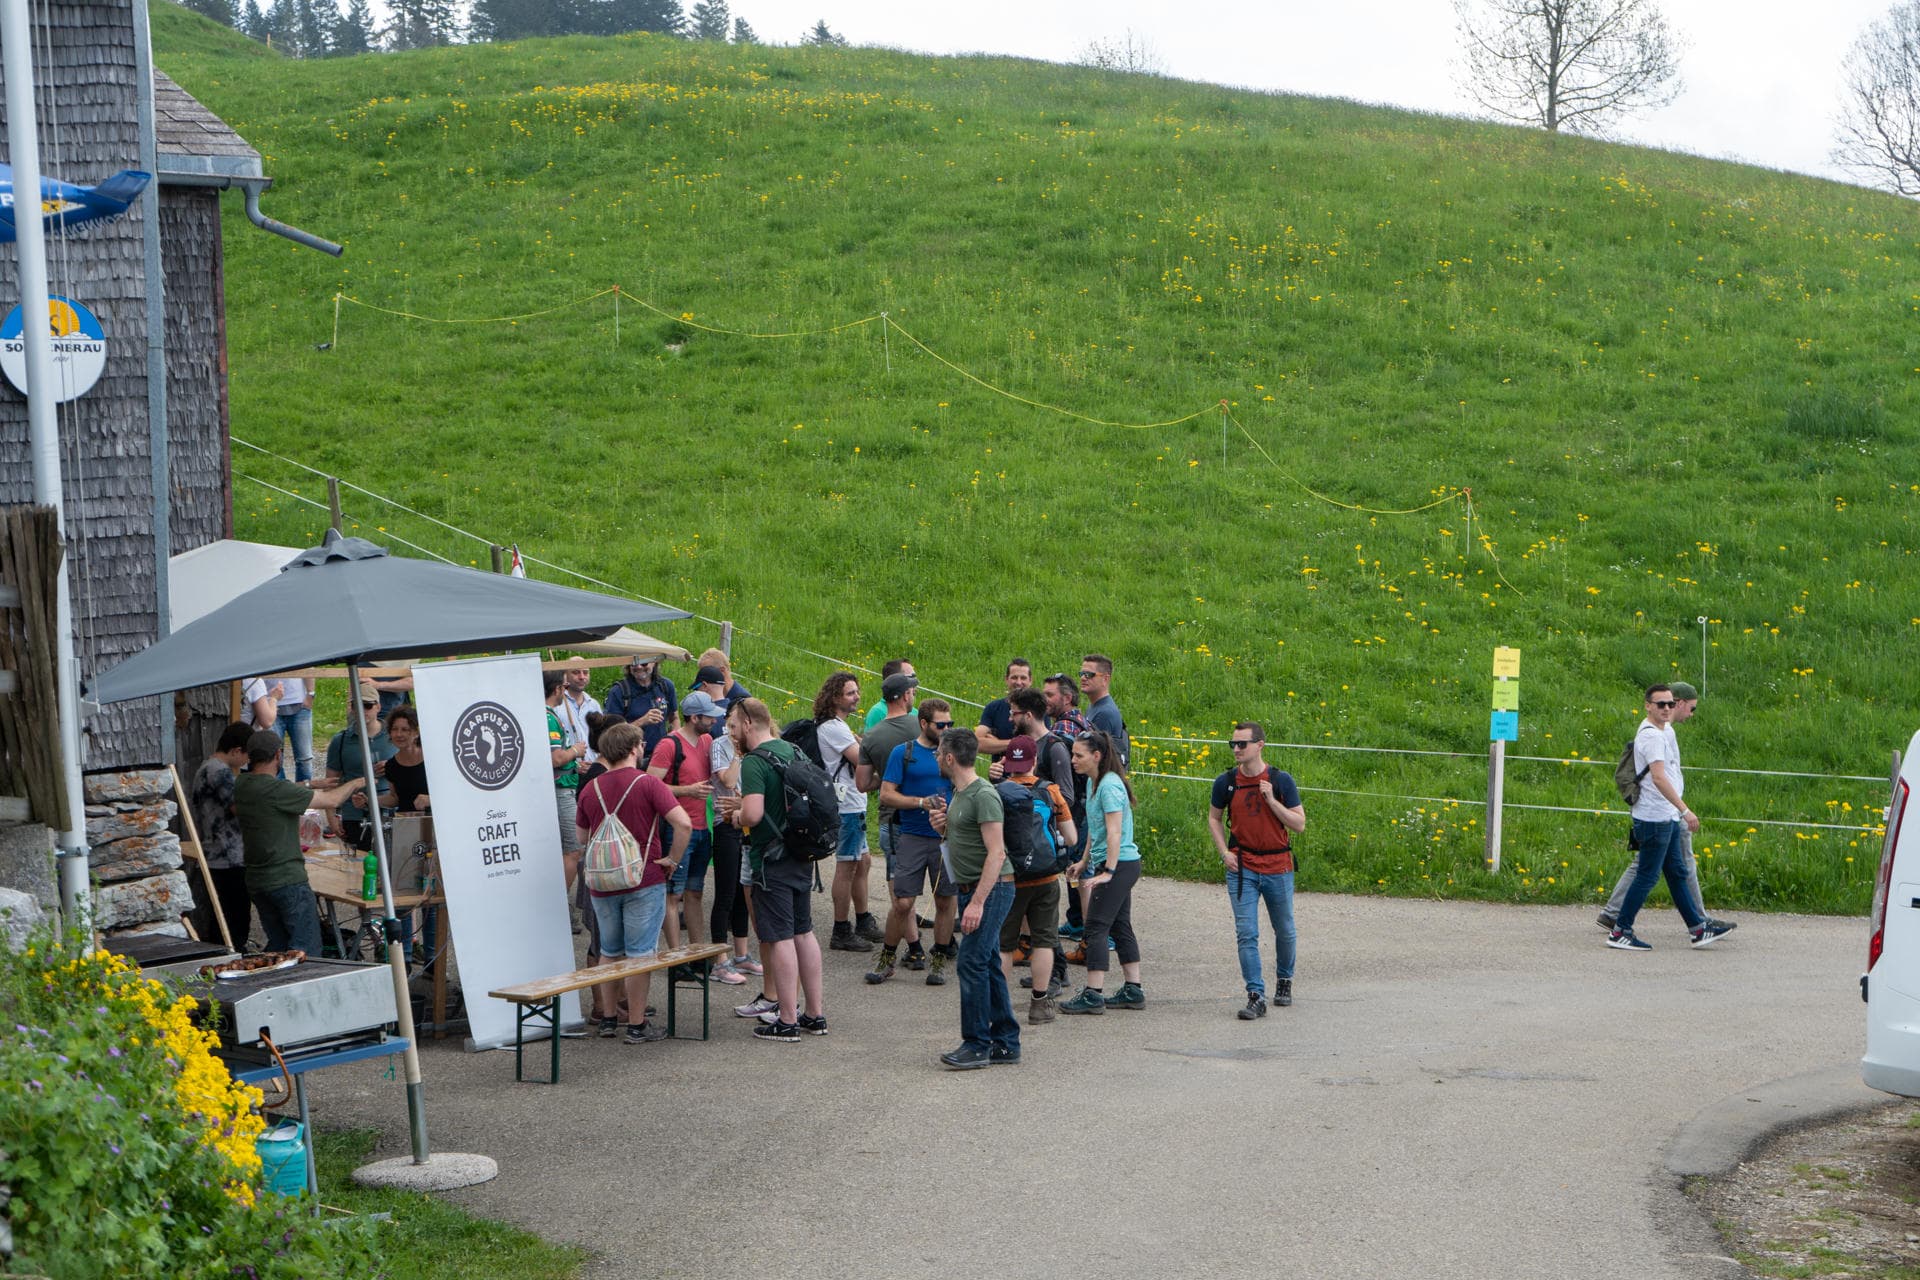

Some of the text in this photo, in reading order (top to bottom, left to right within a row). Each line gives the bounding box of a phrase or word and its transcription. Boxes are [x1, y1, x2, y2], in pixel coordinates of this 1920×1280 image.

[463, 712, 510, 738] BARFUSS
[468, 755, 513, 780] BRAUEREI
[486, 809, 507, 820] Swiss
[478, 821, 518, 842] CRAFT
[482, 843, 521, 866] BEER
